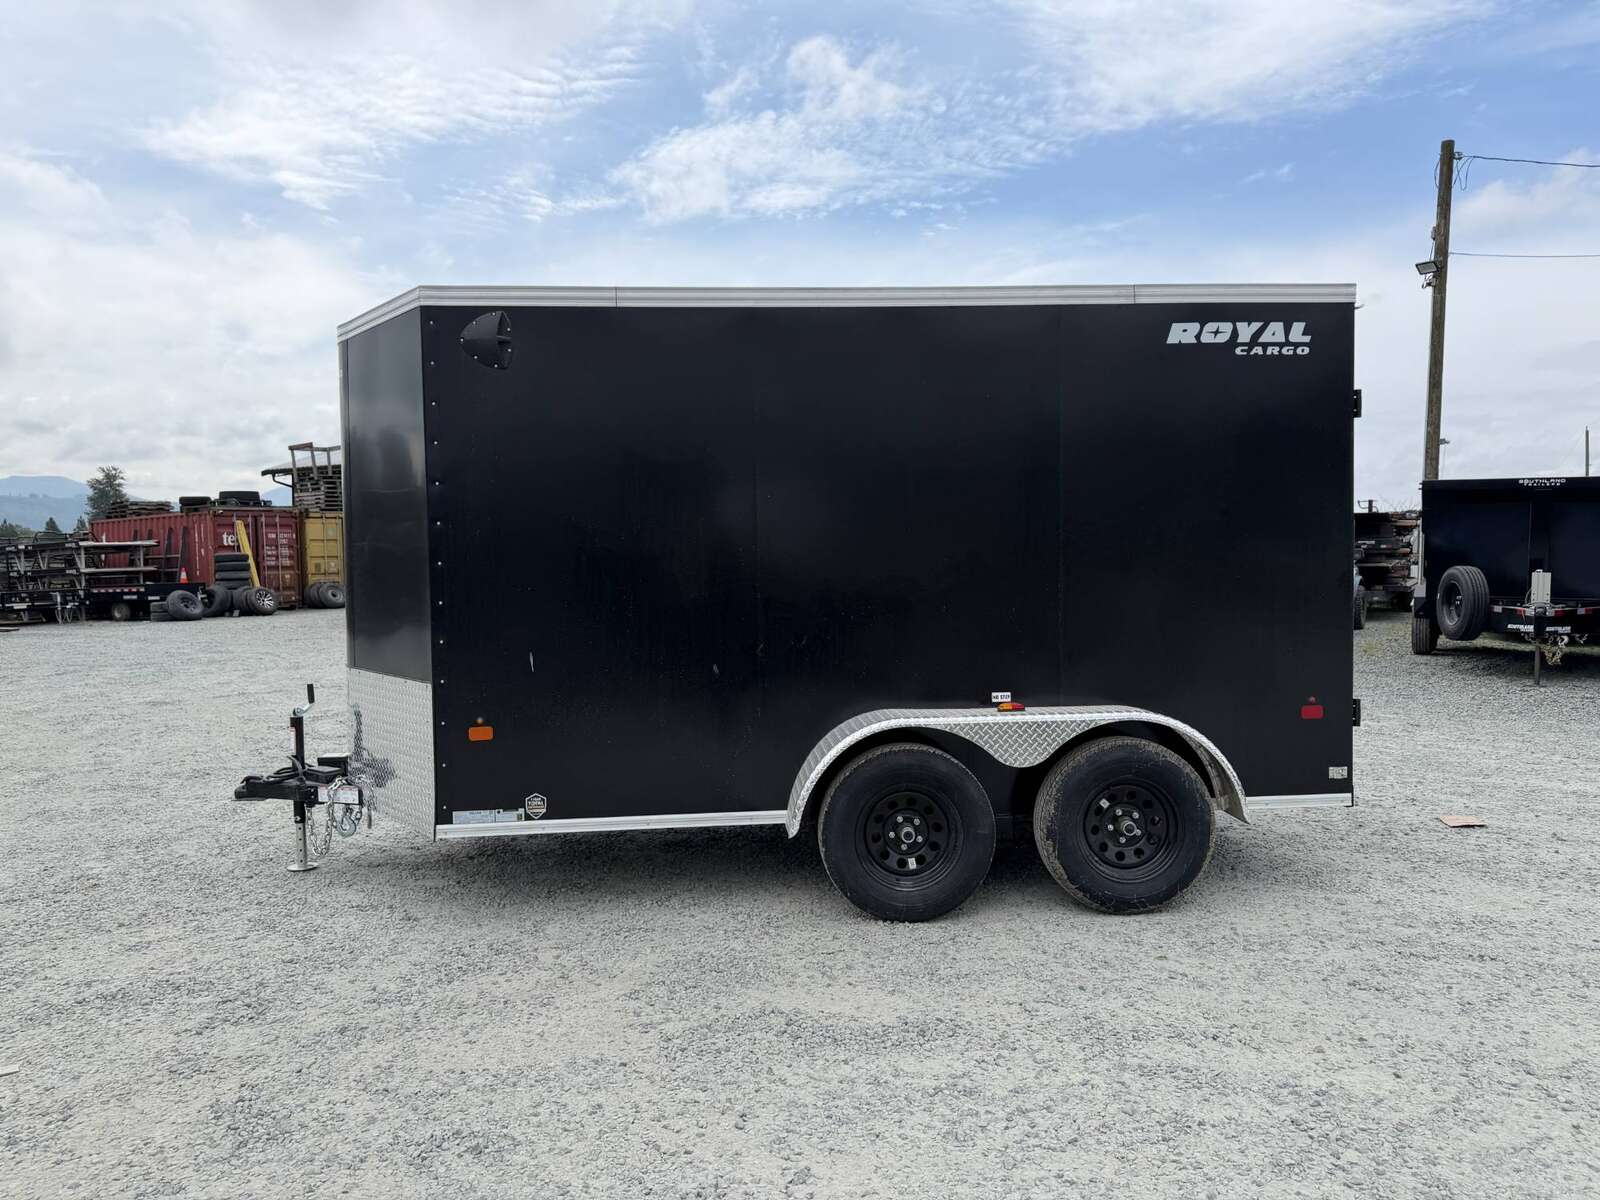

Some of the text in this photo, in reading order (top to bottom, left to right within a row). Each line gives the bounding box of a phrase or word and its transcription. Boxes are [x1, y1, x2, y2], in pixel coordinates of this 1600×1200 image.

[1166, 321, 1312, 344] ROYAL
[1234, 346, 1310, 356] CARGO
[222, 531, 238, 546] te
